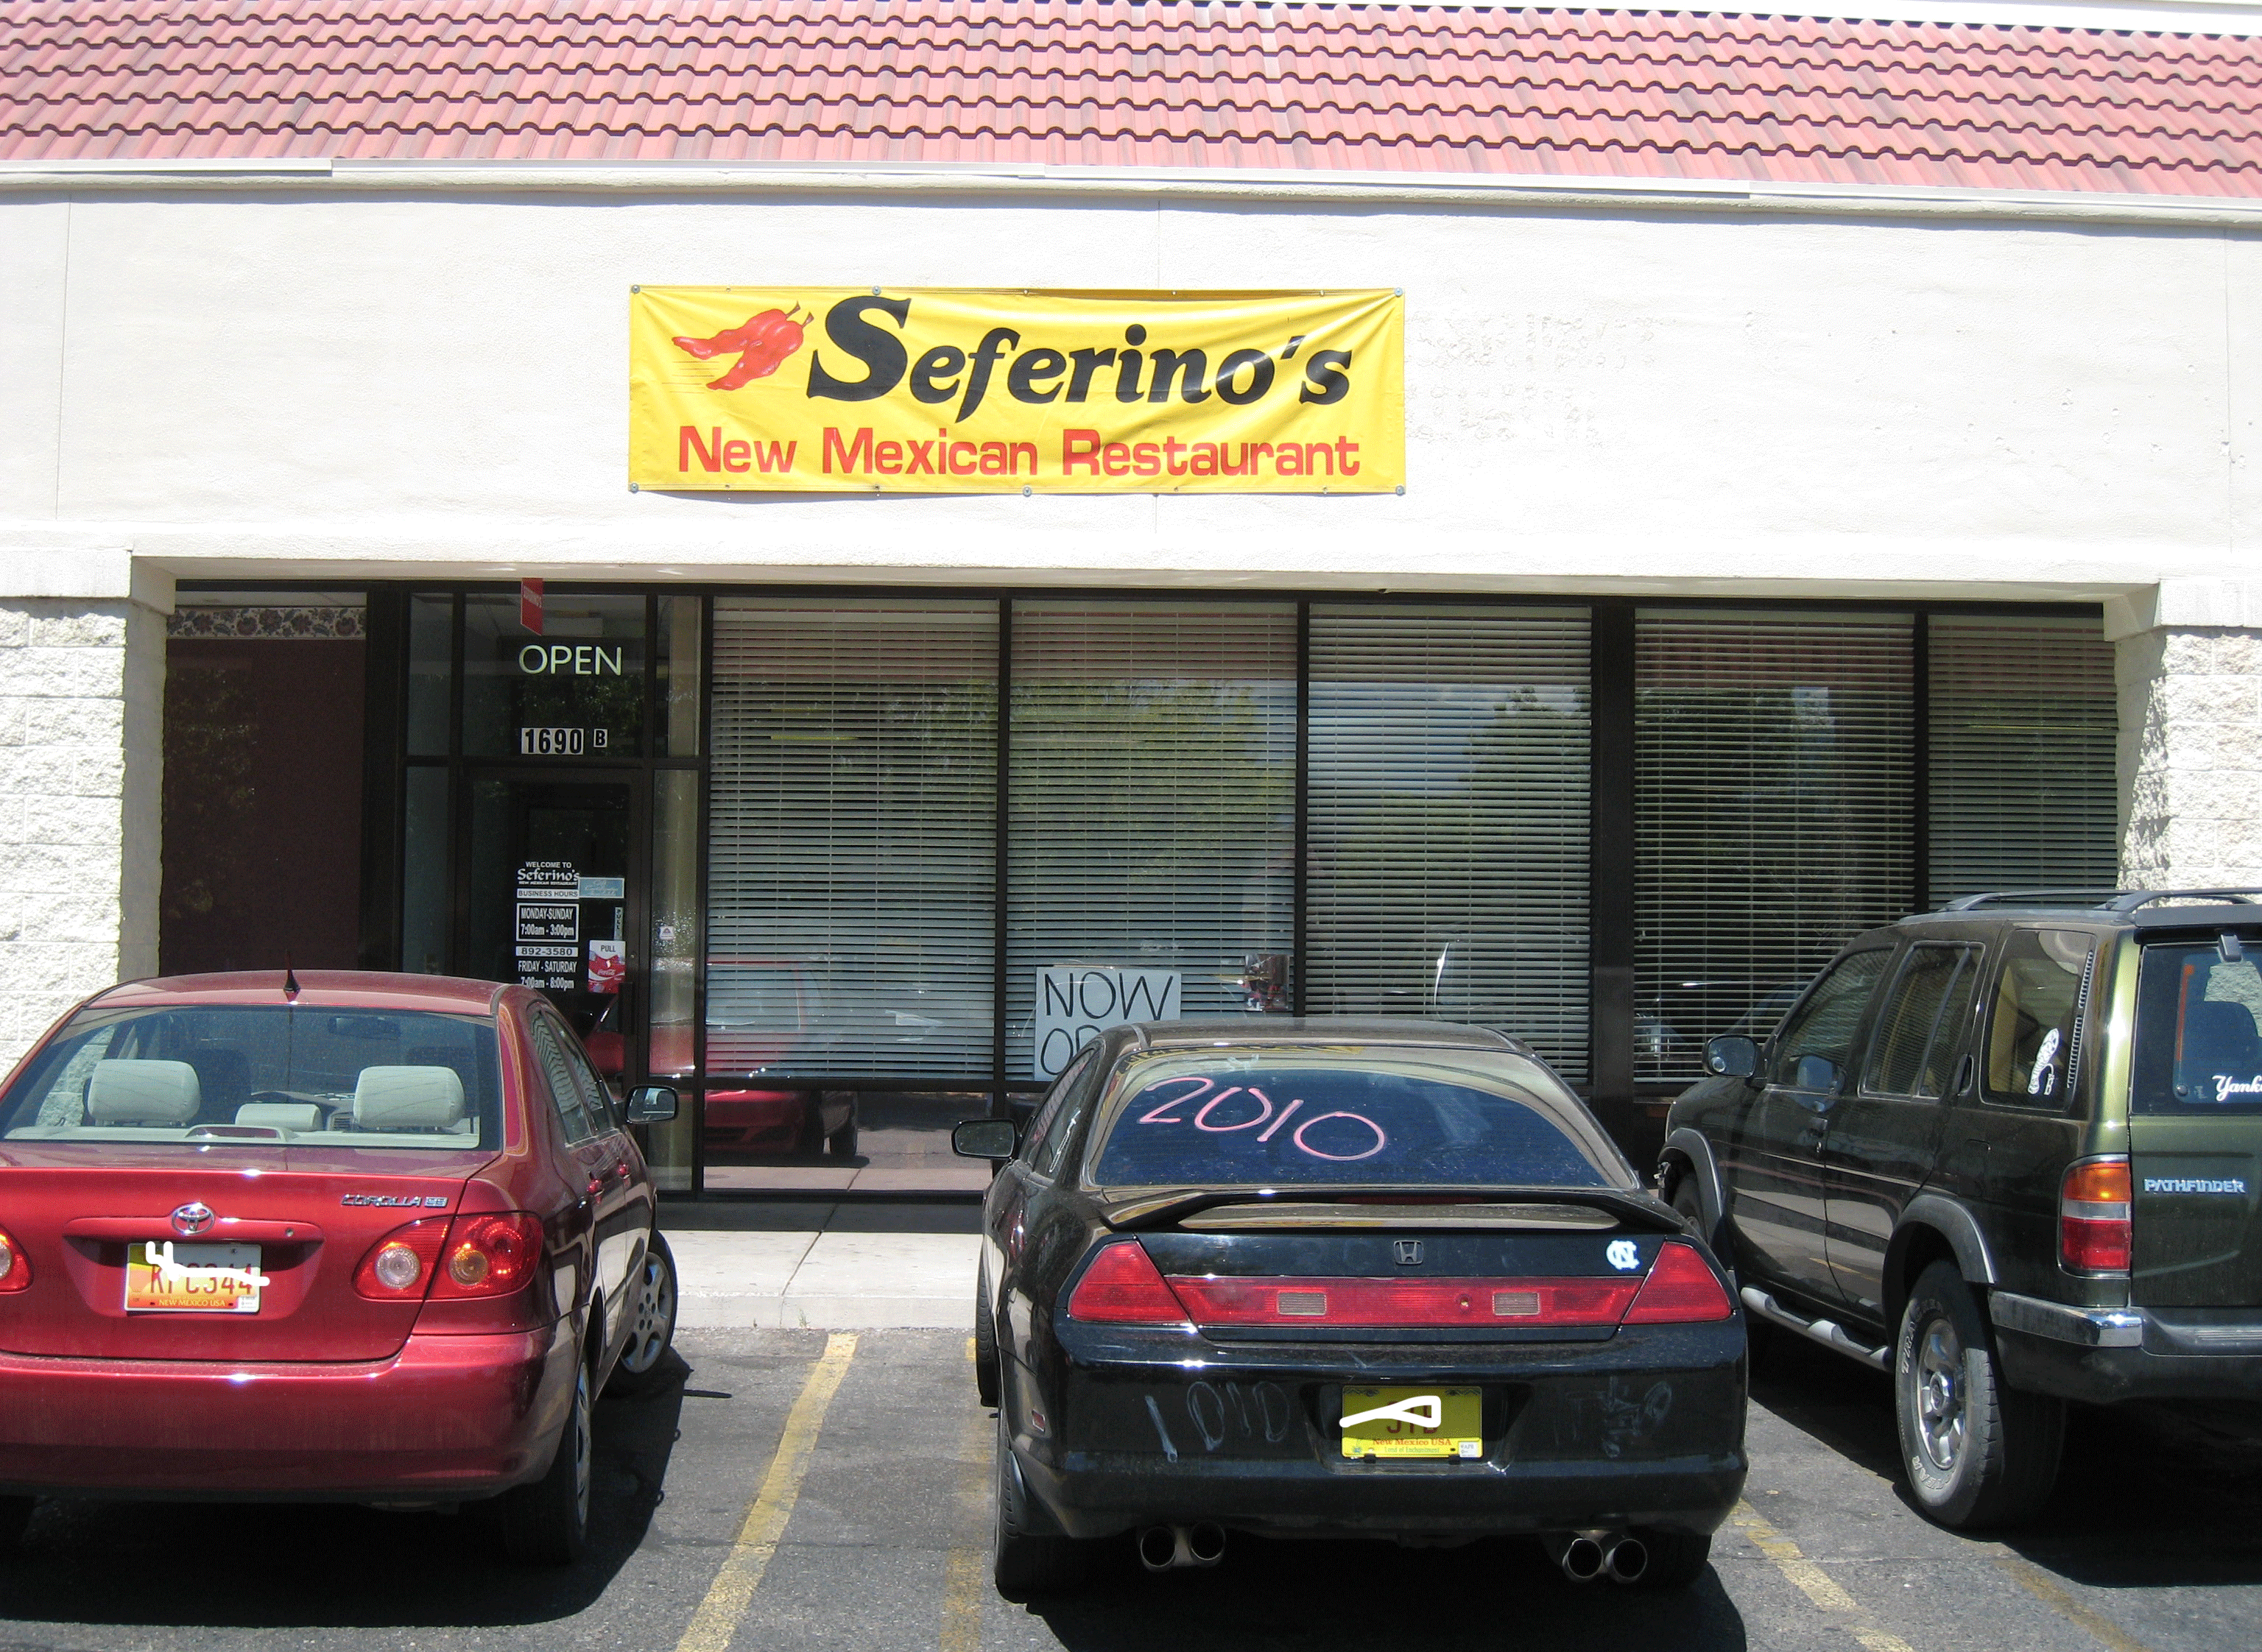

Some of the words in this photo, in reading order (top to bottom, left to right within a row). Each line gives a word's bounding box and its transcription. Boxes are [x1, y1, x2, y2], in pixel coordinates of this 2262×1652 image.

[806, 295, 1353, 423] Seferino's
[678, 426, 797, 473] New
[822, 427, 1037, 476] Mexican
[1062, 428, 1360, 476] Restaurant
[519, 645, 621, 676] OPEN
[524, 729, 582, 754] 1690
[594, 730, 605, 746] B
[517, 868, 580, 881] Seferino's
[521, 923, 545, 936] 7:00am
[550, 923, 574, 939] 3:00pm
[521, 947, 573, 956] 892-3580
[600, 945, 616, 953] PULL
[518, 960, 540, 973] FRIDAY
[544, 960, 577, 973] SATURDAY
[550, 976, 574, 992] 8:00pm
[1044, 971, 1174, 1021] NOW
[2211, 1075, 2262, 1102] Yank
[1138, 1076, 1386, 1161] 2010
[2143, 1179, 2246, 1193] PATHFINDER
[341, 1194, 422, 1207] COROLLA
[209, 1299, 225, 1307] USA
[1431, 1438, 1452, 1446] USA
